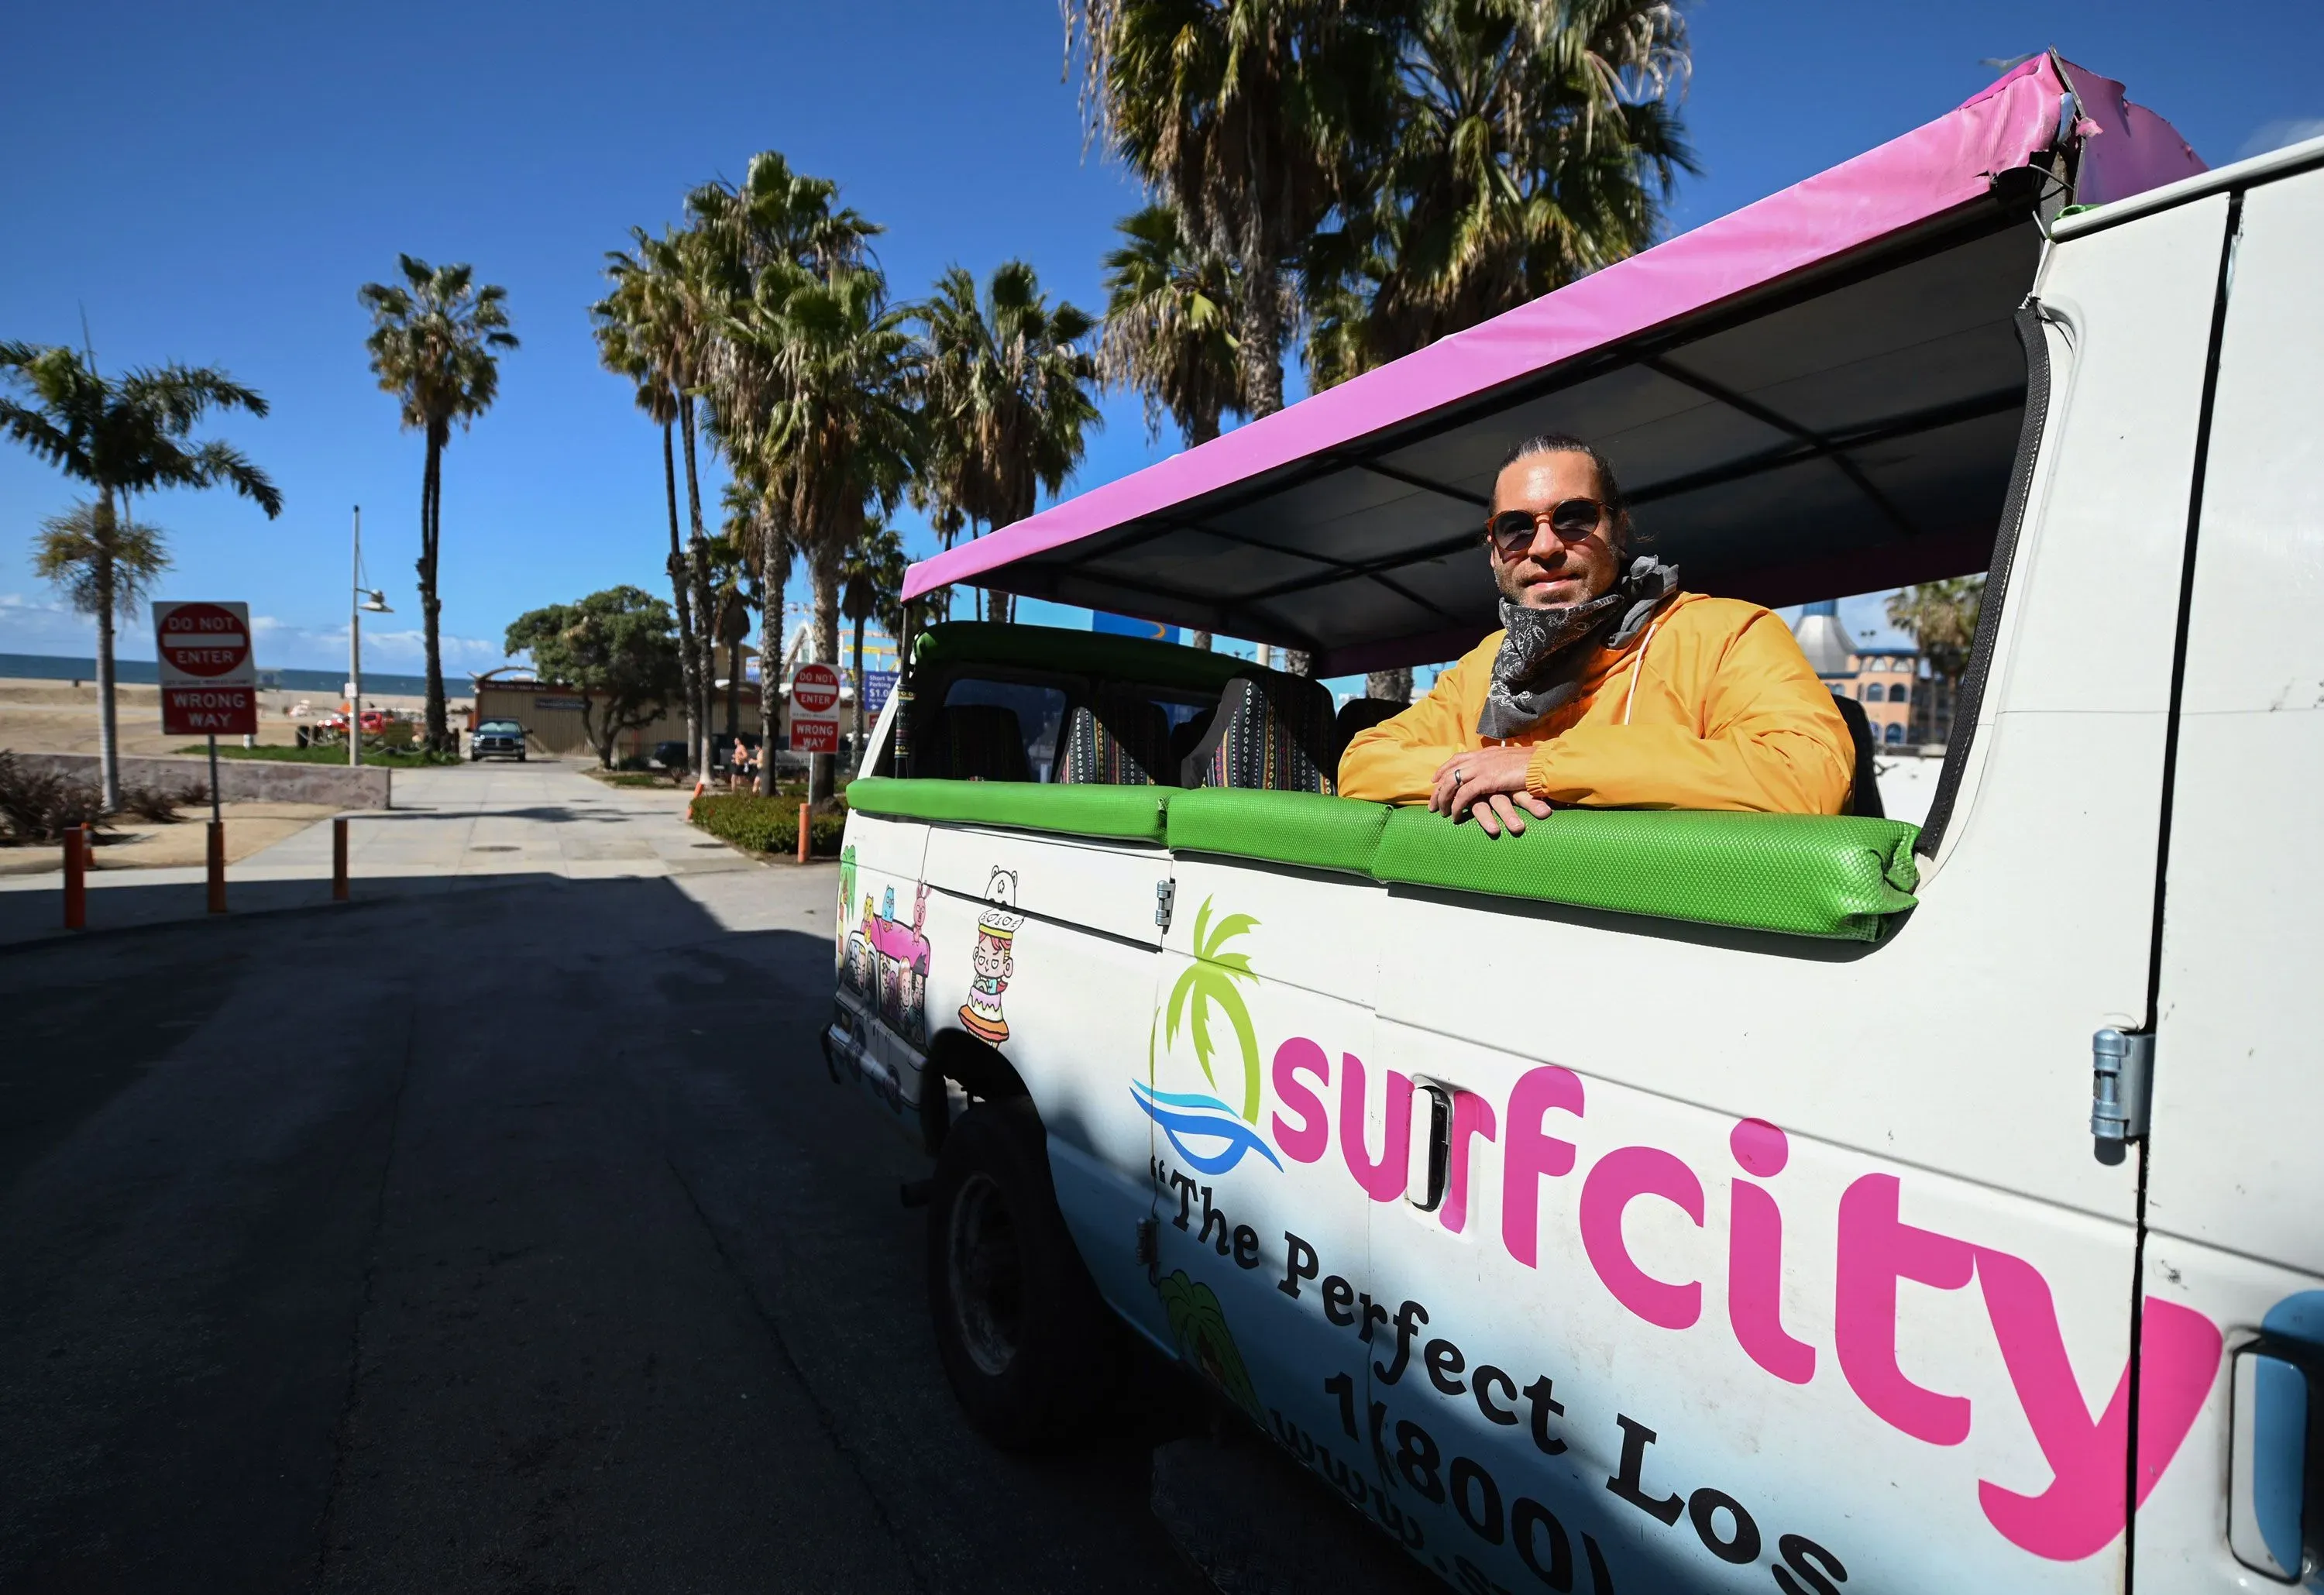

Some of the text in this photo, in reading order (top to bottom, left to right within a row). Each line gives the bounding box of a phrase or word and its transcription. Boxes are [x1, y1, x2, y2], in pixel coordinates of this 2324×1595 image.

[168, 617, 234, 631] DO NOT
[176, 651, 233, 664] ENTER
[799, 672, 833, 683] DO NOT
[172, 693, 246, 708] WRONG
[801, 694, 830, 704] ENTER
[188, 713, 231, 727] WAY
[796, 724, 833, 736] WRONG
[803, 737, 826, 748] WAY
[1272, 1037, 2223, 1562] surfcity
[1277, 1230, 1569, 1456] Perfect
[1606, 1412, 1848, 1595] Los
